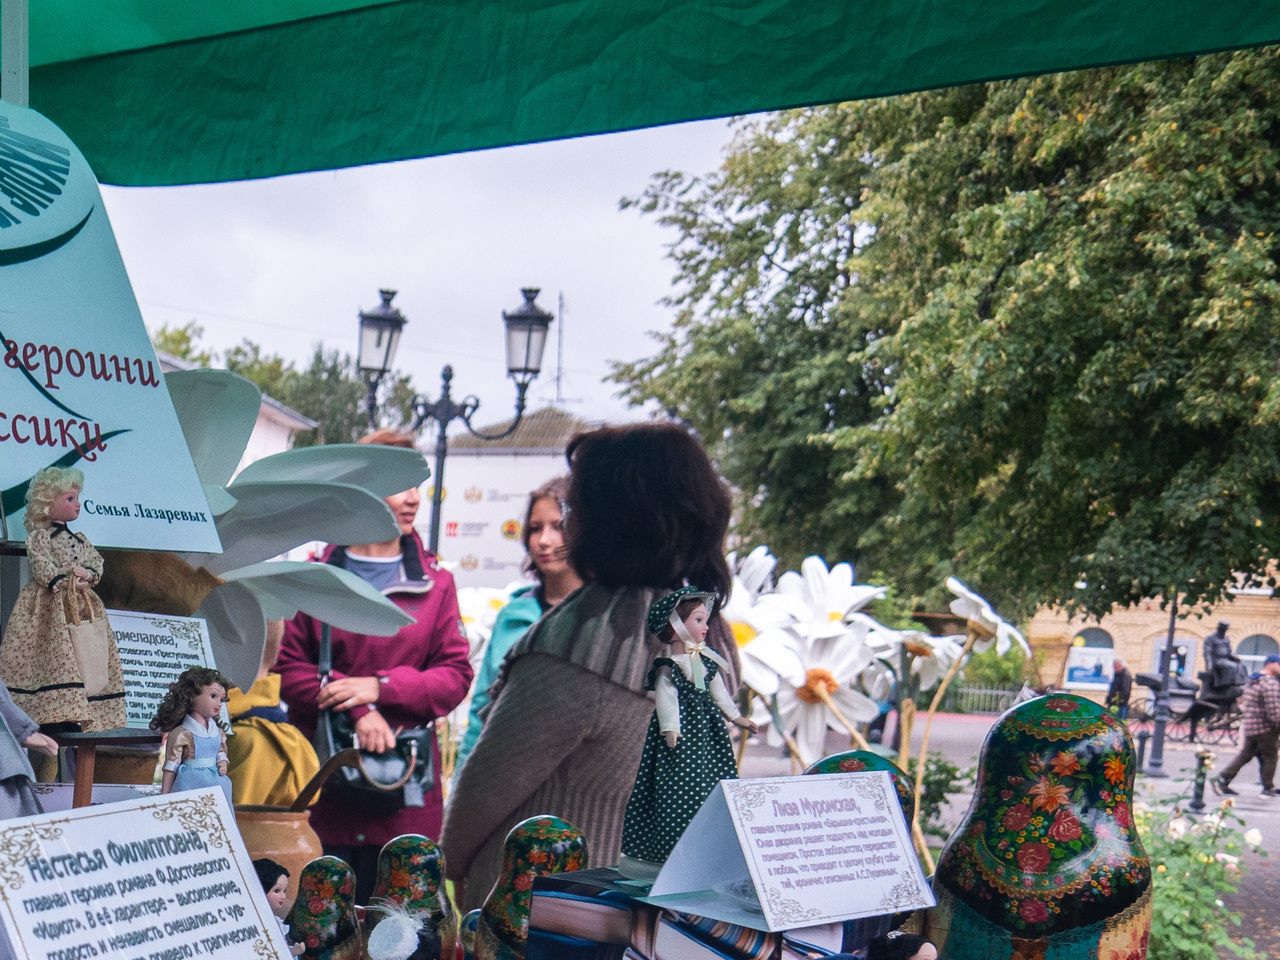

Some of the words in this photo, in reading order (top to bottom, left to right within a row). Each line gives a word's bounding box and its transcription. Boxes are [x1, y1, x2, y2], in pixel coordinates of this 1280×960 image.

[3, 336, 160, 389] героини
[83, 500, 128, 520] Семья
[132, 503, 208, 523] Лазаревых
[115, 631, 178, 648] рмеладова,
[772, 800, 800, 817] Лиза
[25, 848, 108, 882] Настасья
[107, 830, 208, 866] Филипповна,
[71, 881, 117, 905] героиня
[116, 873, 156, 898] романа
[155, 857, 231, 886] Ф.Достоевского
[84, 910, 96, 929] В
[97, 906, 113, 926] её
[112, 897, 167, 923] характере
[175, 879, 242, 907] высокомерие,
[97, 939, 108, 953] и
[109, 925, 164, 952] ненависть
[164, 912, 218, 936] смешались
[218, 908, 226, 922] с
[227, 904, 245, 921] чув-
[192, 941, 202, 955] к
[200, 924, 260, 956] трагическим
